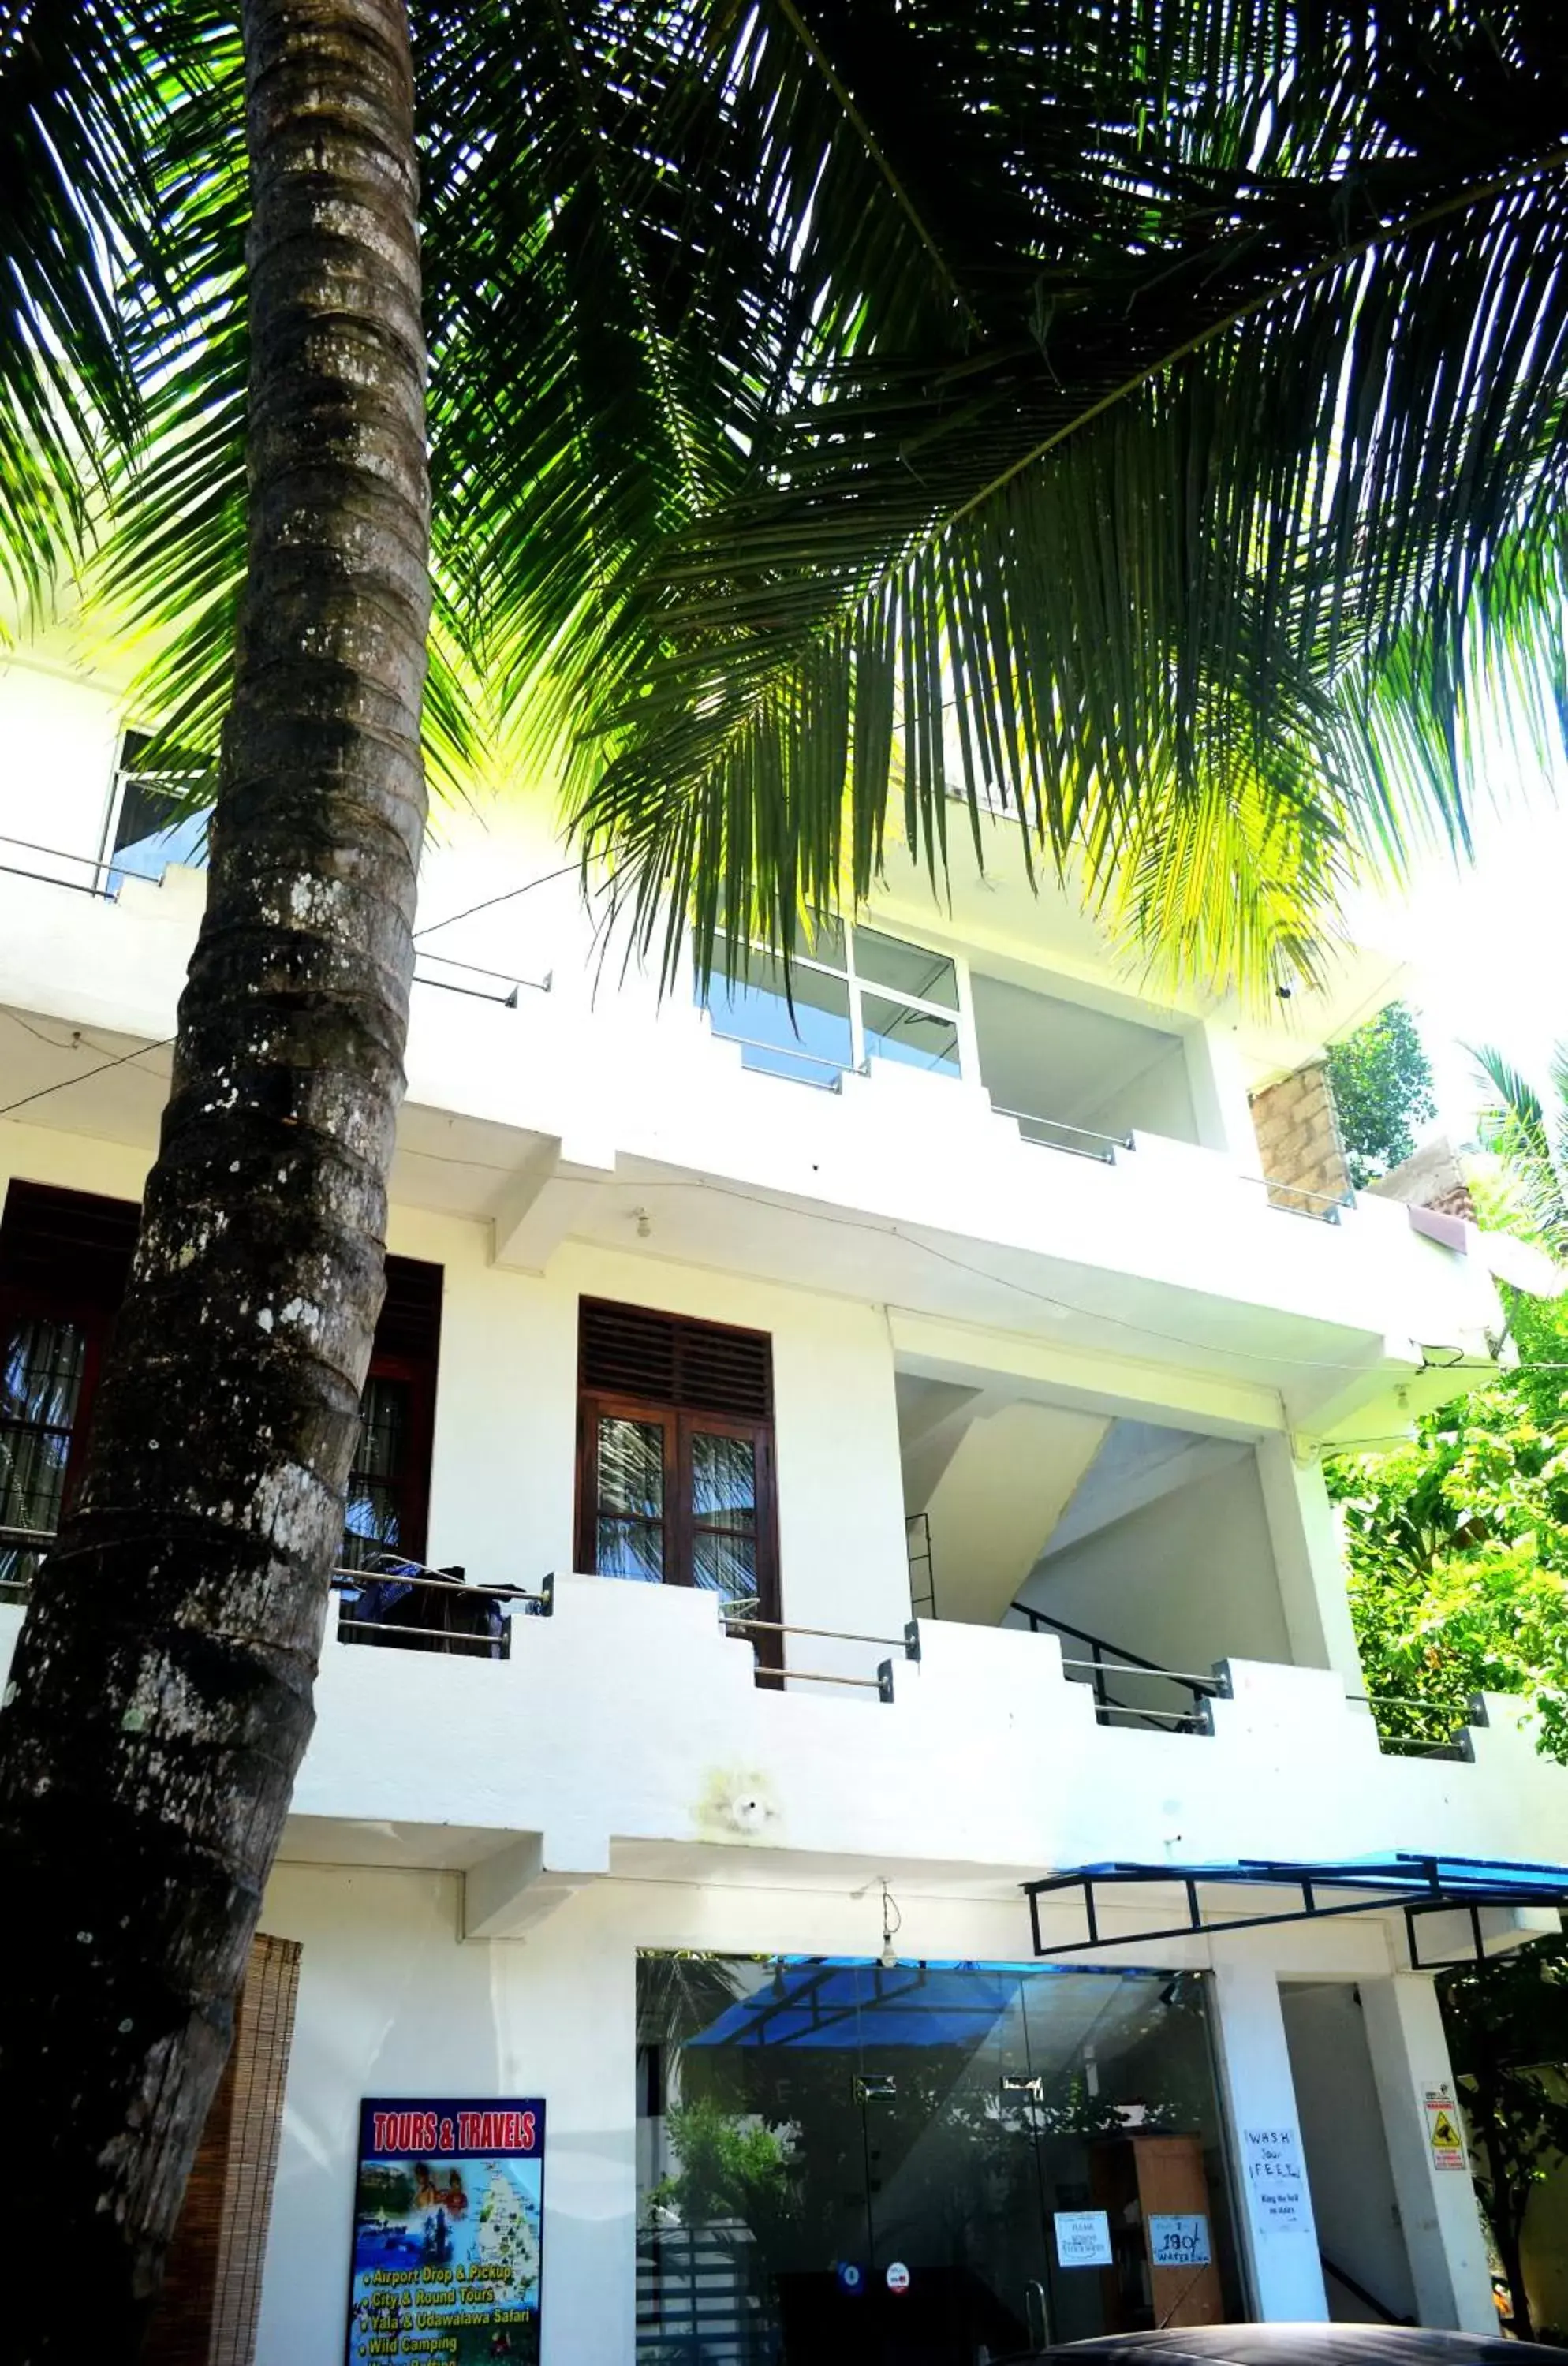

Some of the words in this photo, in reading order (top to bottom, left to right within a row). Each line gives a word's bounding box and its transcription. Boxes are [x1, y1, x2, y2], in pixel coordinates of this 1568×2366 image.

[374, 2112, 437, 2151] TOURS
[439, 2118, 454, 2151] &
[457, 2112, 535, 2150] TRAVELS
[1249, 2133, 1290, 2144] WASH
[372, 2270, 419, 2286] Airport
[422, 2266, 453, 2283] Drop
[457, 2267, 465, 2282] &
[469, 2265, 512, 2282] Pickup
[371, 2291, 397, 2308] City
[401, 2292, 411, 2305] &
[416, 2289, 455, 2304] Round
[460, 2288, 495, 2302] Tours
[371, 2315, 398, 2331] Yala
[404, 2314, 413, 2329] &
[417, 2312, 489, 2328] Udawalawa
[494, 2309, 529, 2323] Safari
[368, 2338, 395, 2353] Wild
[401, 2336, 457, 2353] Camping
